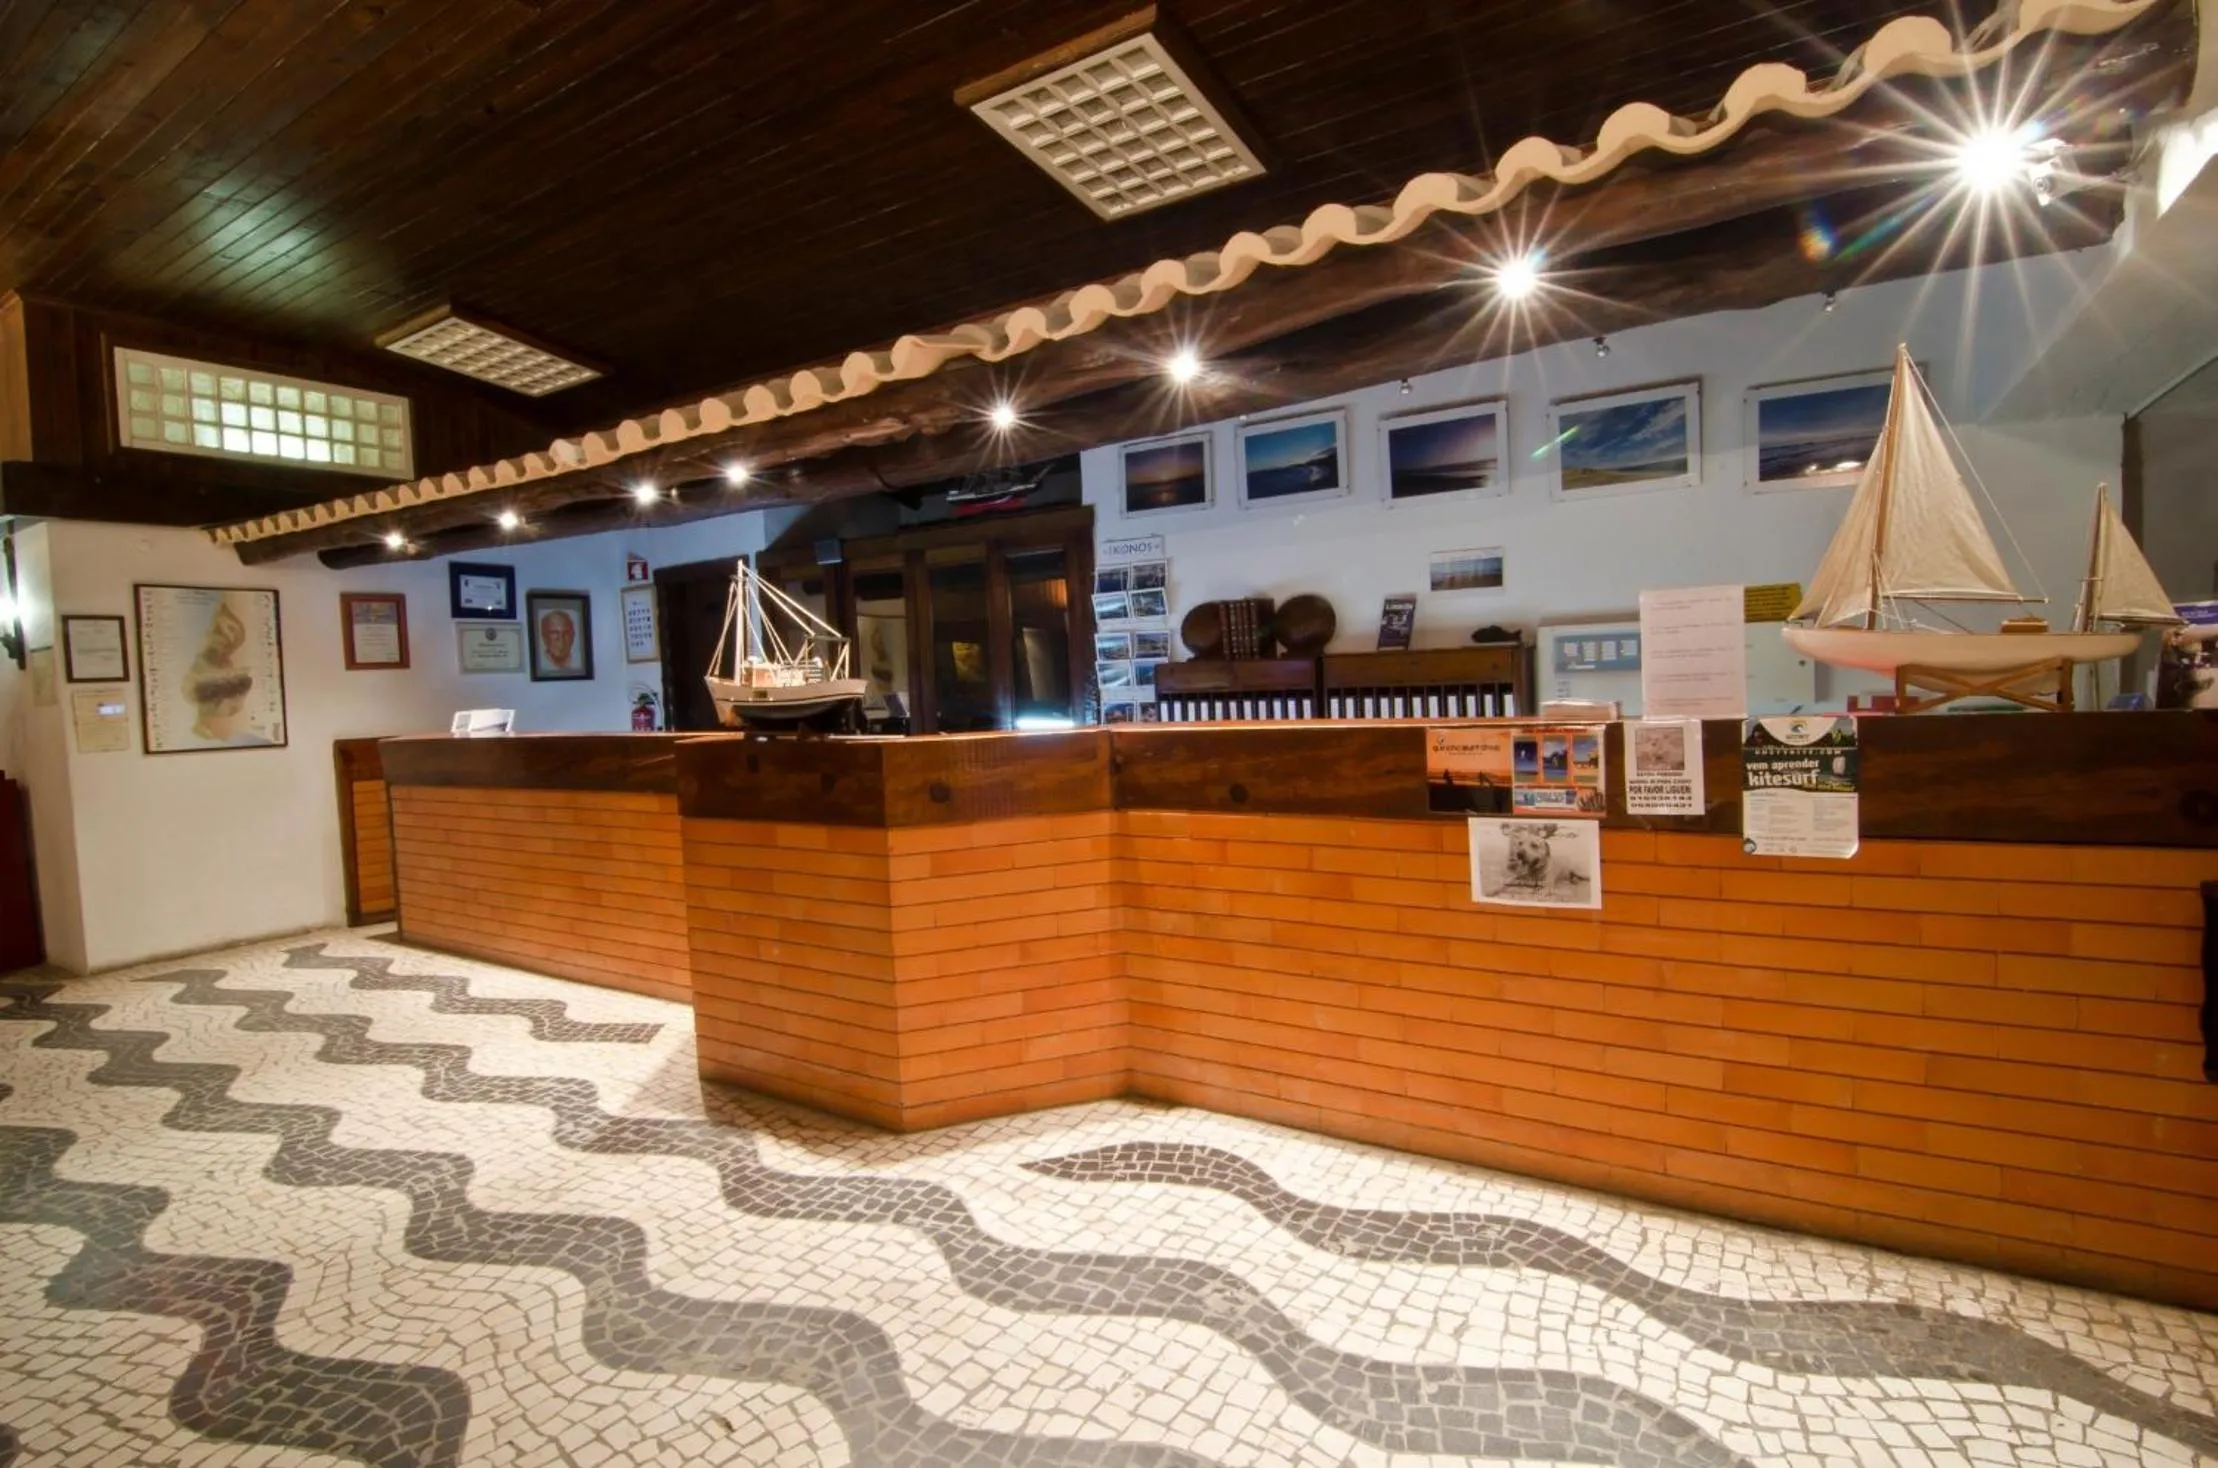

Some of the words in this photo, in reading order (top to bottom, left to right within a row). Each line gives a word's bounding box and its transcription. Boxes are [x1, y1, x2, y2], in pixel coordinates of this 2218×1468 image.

[1746, 761, 1769, 771] vem
[1771, 758, 1820, 771] aprender
[1748, 769, 1820, 787] kitesurf
